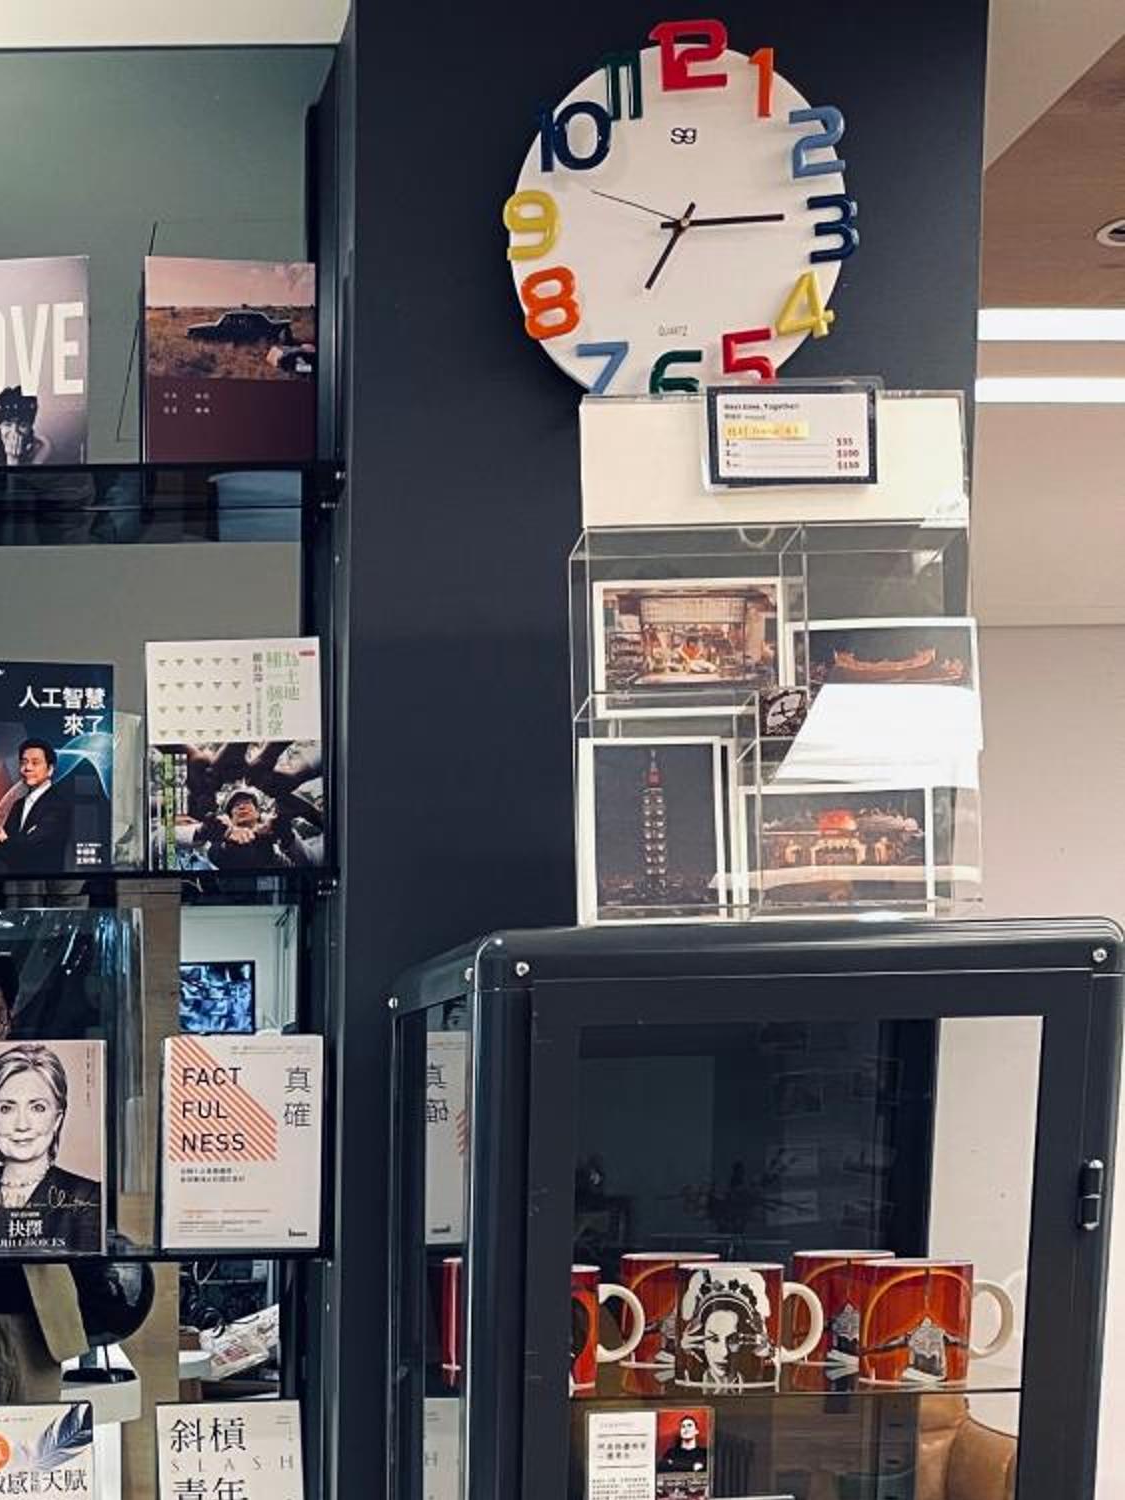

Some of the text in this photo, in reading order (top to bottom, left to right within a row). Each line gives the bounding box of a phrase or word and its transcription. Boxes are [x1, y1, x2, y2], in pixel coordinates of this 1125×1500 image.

[647, 19, 728, 93] 12
[748, 48, 774, 118] 1
[604, 54, 643, 121] 11
[537, 101, 612, 172] 10
[789, 105, 845, 179] 2
[504, 190, 559, 261] 9
[807, 194, 860, 264] 3
[521, 266, 581, 339] 8
[779, 271, 834, 339] 4
[576, 342, 629, 395] 7
[723, 328, 777, 386] 5
[19, 685, 106, 710] 人工智慧
[63, 713, 105, 736] 來了
[182, 1067, 243, 1087] FACT
[283, 1066, 312, 1128] 真確
[182, 1101, 228, 1119] FUL
[181, 1133, 246, 1153] NESS
[170, 1417, 247, 1453] 斜槓
[170, 1455, 295, 1473] SLASH
